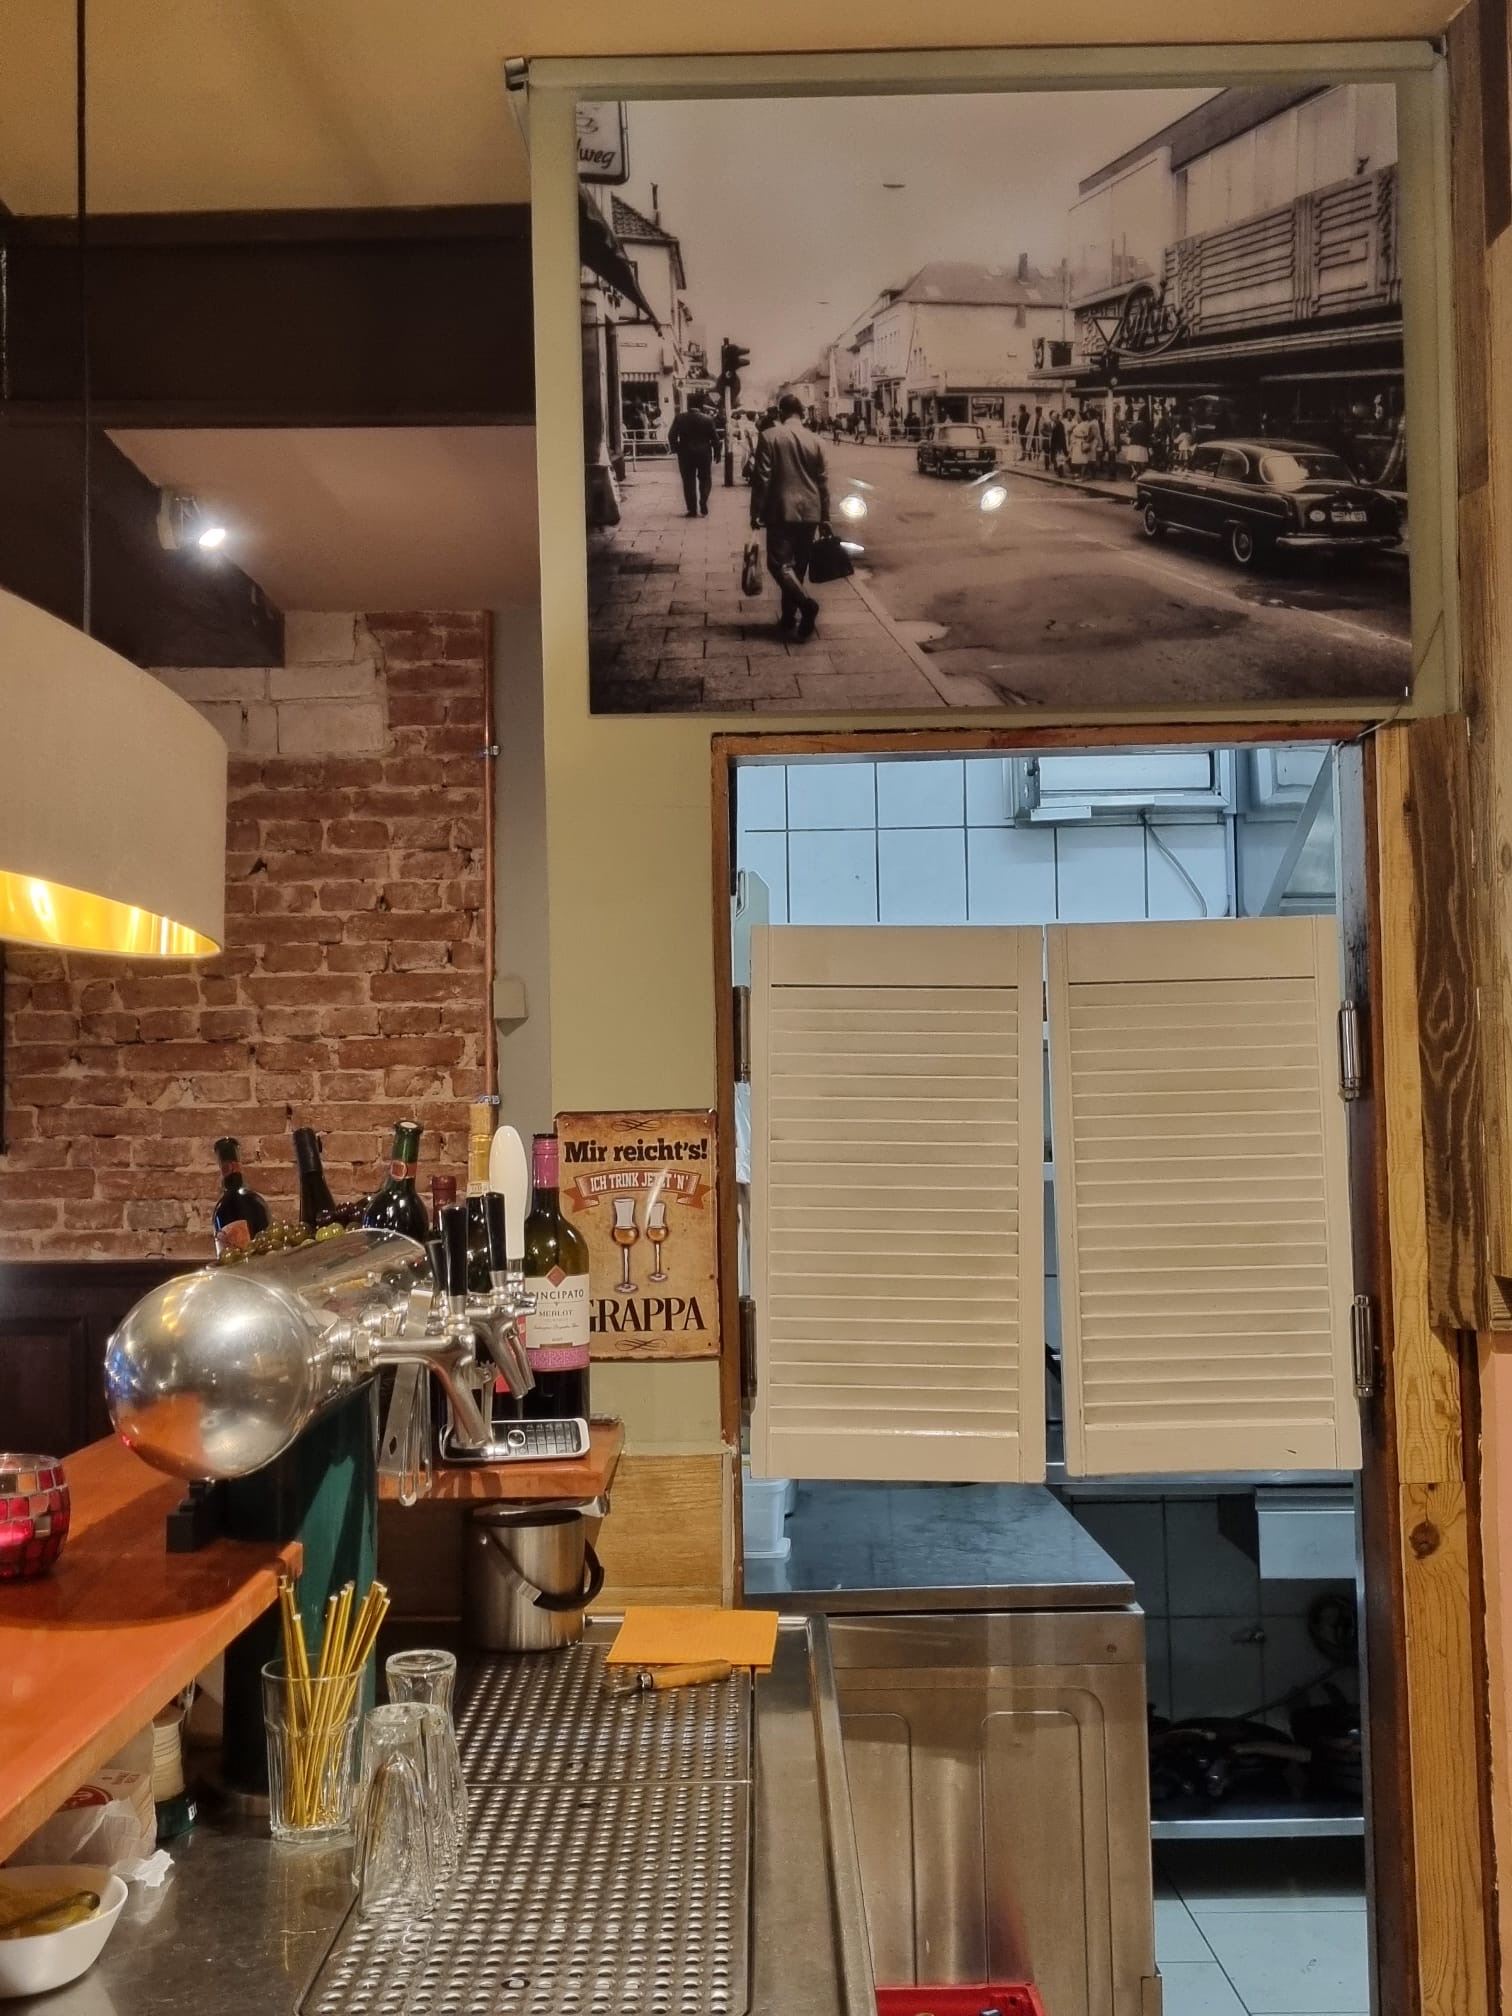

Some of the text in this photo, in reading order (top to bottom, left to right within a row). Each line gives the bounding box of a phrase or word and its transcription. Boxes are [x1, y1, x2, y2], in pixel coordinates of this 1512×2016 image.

[564, 1138, 708, 1162] Mir reicht's!
[590, 1175, 607, 1192] ICH
[609, 1172, 639, 1190] TRINK
[641, 1172, 673, 1188] JET
[528, 1289, 584, 1300] INCIPATO
